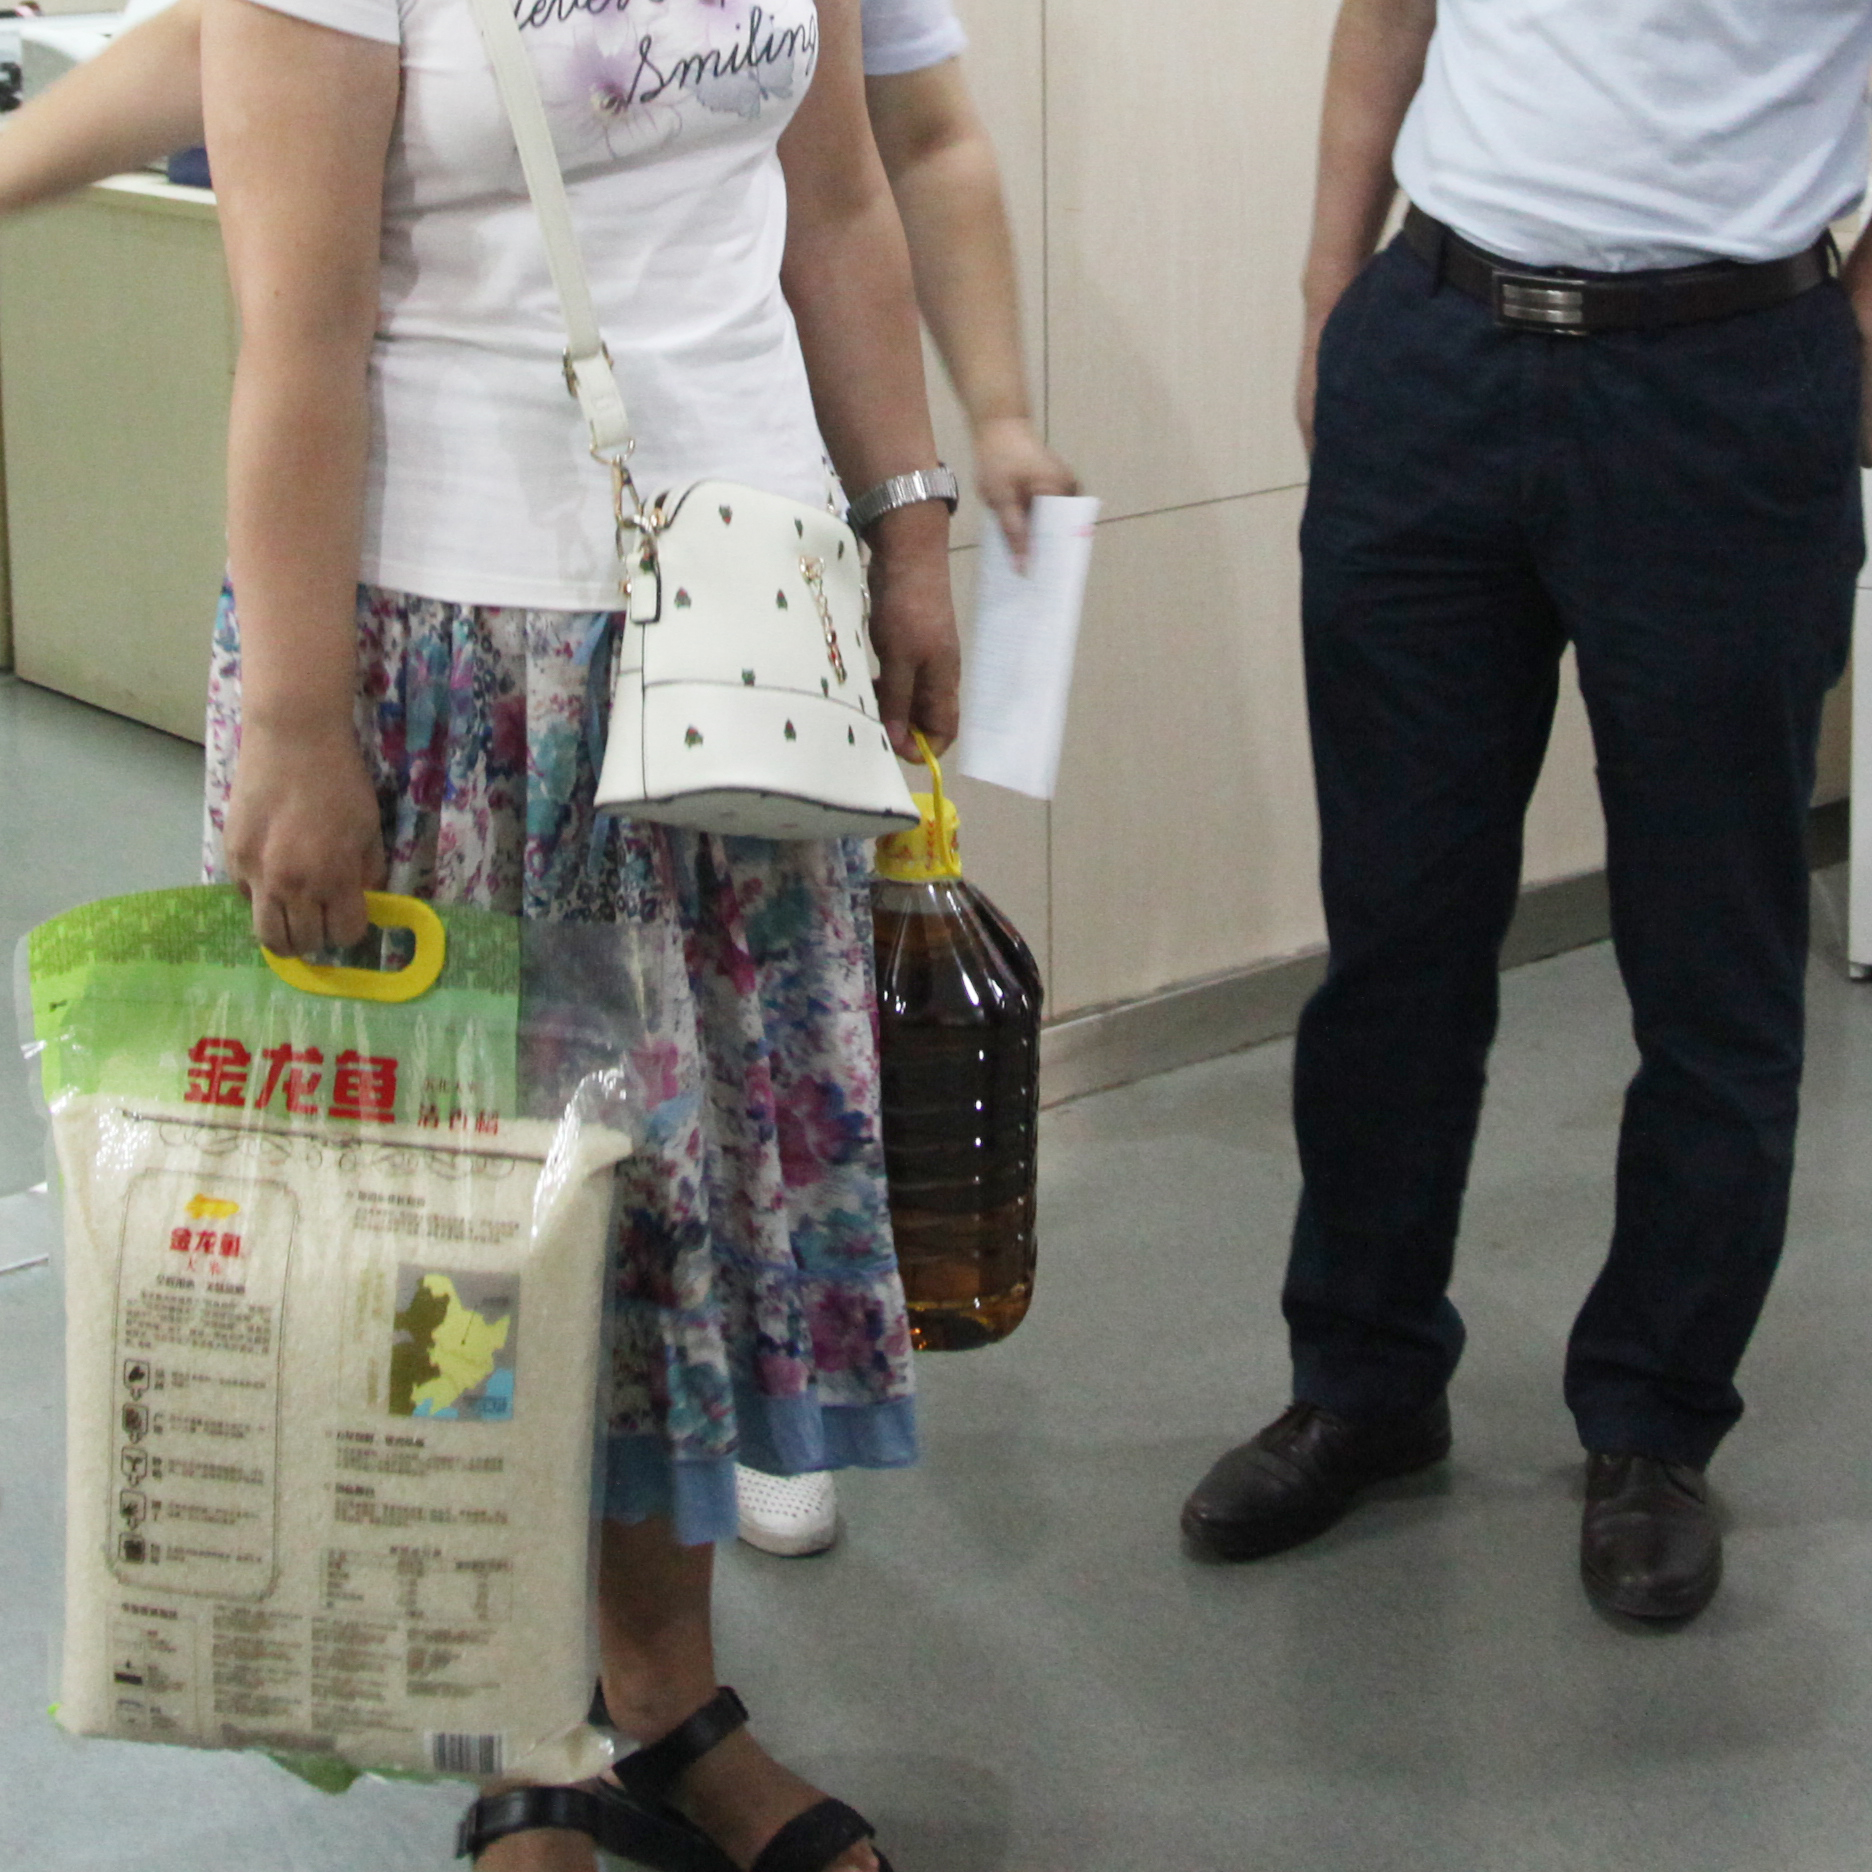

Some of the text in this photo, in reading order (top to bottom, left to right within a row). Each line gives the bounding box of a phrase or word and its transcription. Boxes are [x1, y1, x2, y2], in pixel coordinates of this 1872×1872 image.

[184, 1037, 398, 1124] 金龙鱼
[169, 1227, 242, 1258] 金龙鱼
